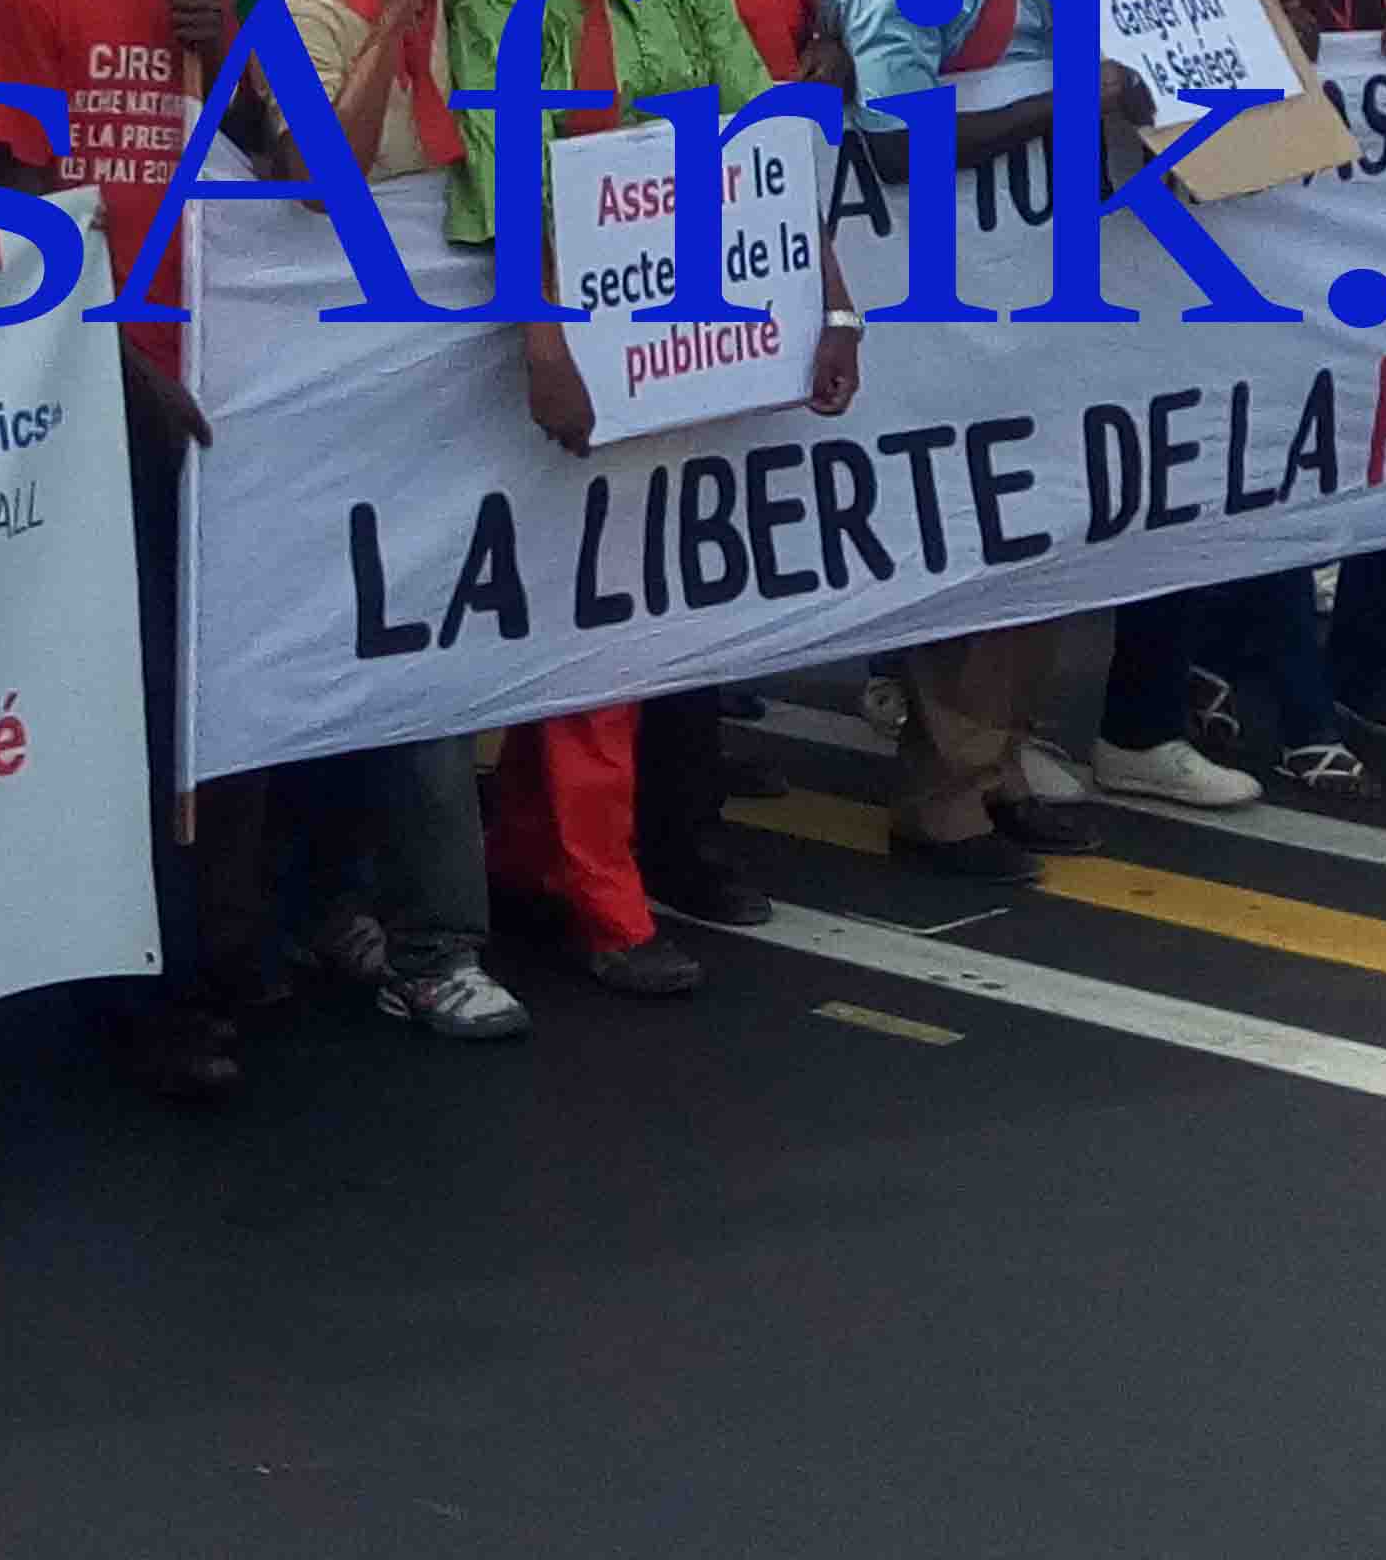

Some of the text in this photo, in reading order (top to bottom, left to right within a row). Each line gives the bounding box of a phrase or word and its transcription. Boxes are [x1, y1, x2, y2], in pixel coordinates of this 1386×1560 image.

[88, 44, 172, 82] CJRS
[87, 123, 115, 149] LA
[93, 157, 136, 183] MAI
[752, 145, 786, 199] le
[725, 229, 771, 284] de
[779, 221, 811, 274] la
[625, 301, 783, 399] publicité
[349, 501, 530, 659] LA
[574, 415, 1053, 629] LIBERTE
[1083, 387, 1202, 544] DE
[1224, 367, 1339, 515] LA
